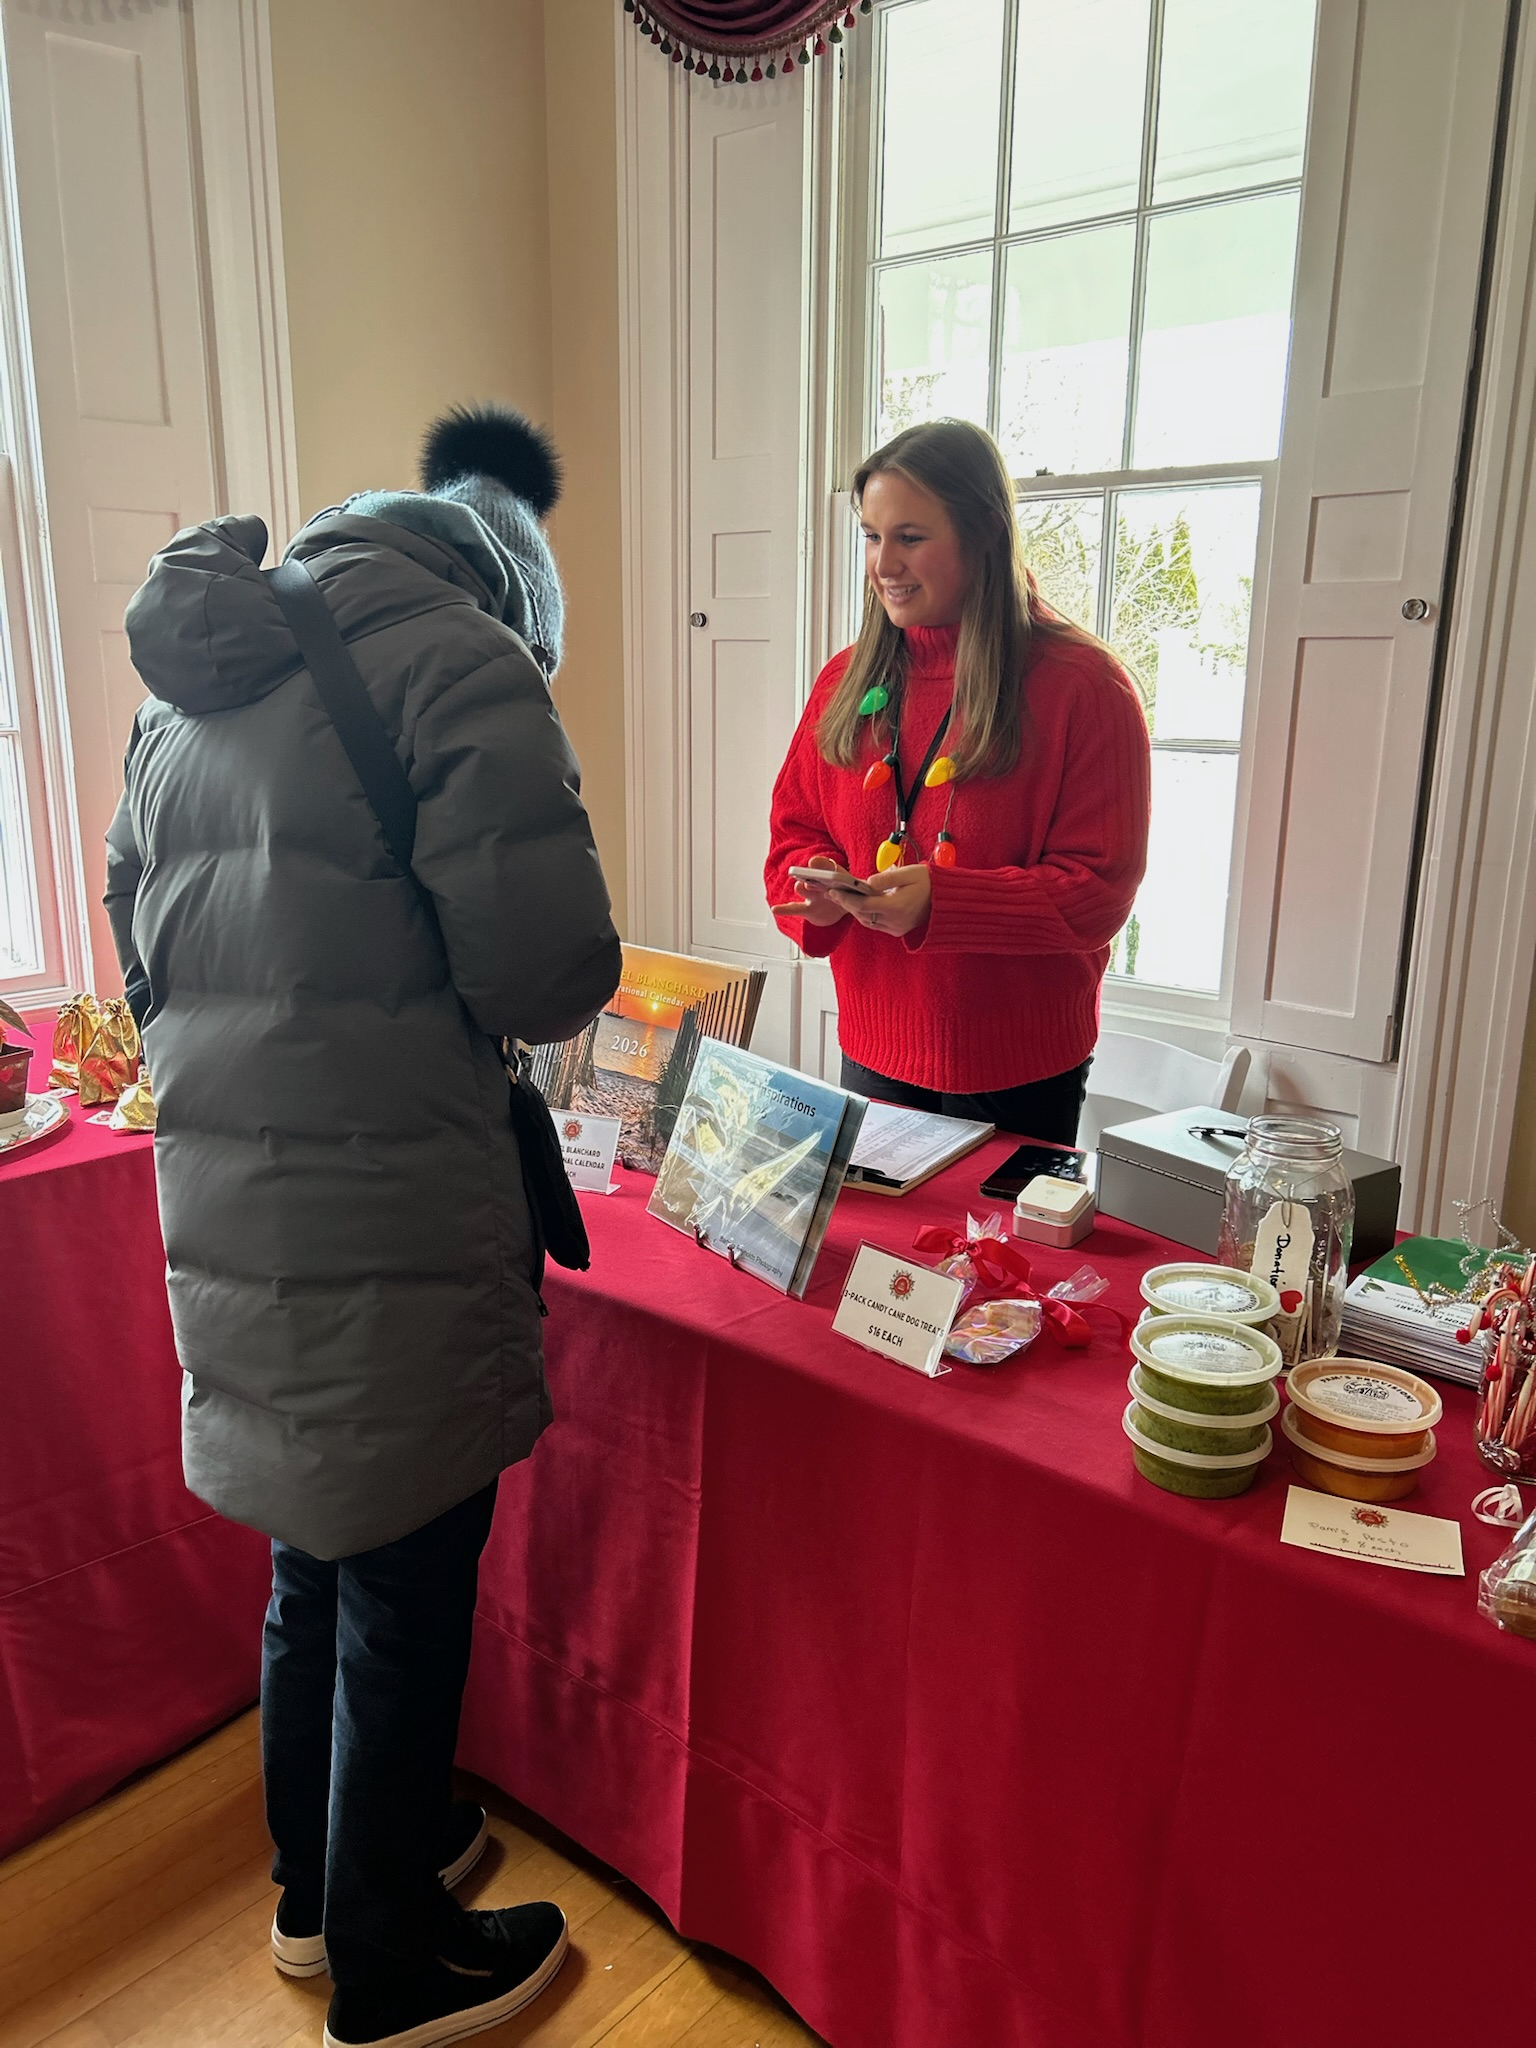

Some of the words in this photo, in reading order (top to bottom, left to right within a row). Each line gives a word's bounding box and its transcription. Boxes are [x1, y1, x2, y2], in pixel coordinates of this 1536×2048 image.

[617, 985, 648, 998] rational
[649, 991, 685, 1007] Calendar
[636, 973, 706, 999] BLANCHARD
[611, 1035, 648, 1058] 2026
[756, 1086, 817, 1118] nspirations
[566, 1146, 601, 1158] BLANCHARD
[574, 1158, 606, 1170] CALENDAR
[755, 1256, 783, 1278] Photography
[844, 1289, 867, 1305] 3-PACK
[867, 1299, 888, 1314] CANDY
[888, 1308, 907, 1322] CANE
[906, 1315, 920, 1327] DOG
[920, 1320, 945, 1338] TREATS
[1395, 1304, 1425, 1315] HEART
[868, 1325, 881, 1338] $16
[881, 1330, 904, 1347] EACH
[1355, 1376, 1417, 1403] PROVISIONS
[1362, 1533, 1410, 1548] Pesto
